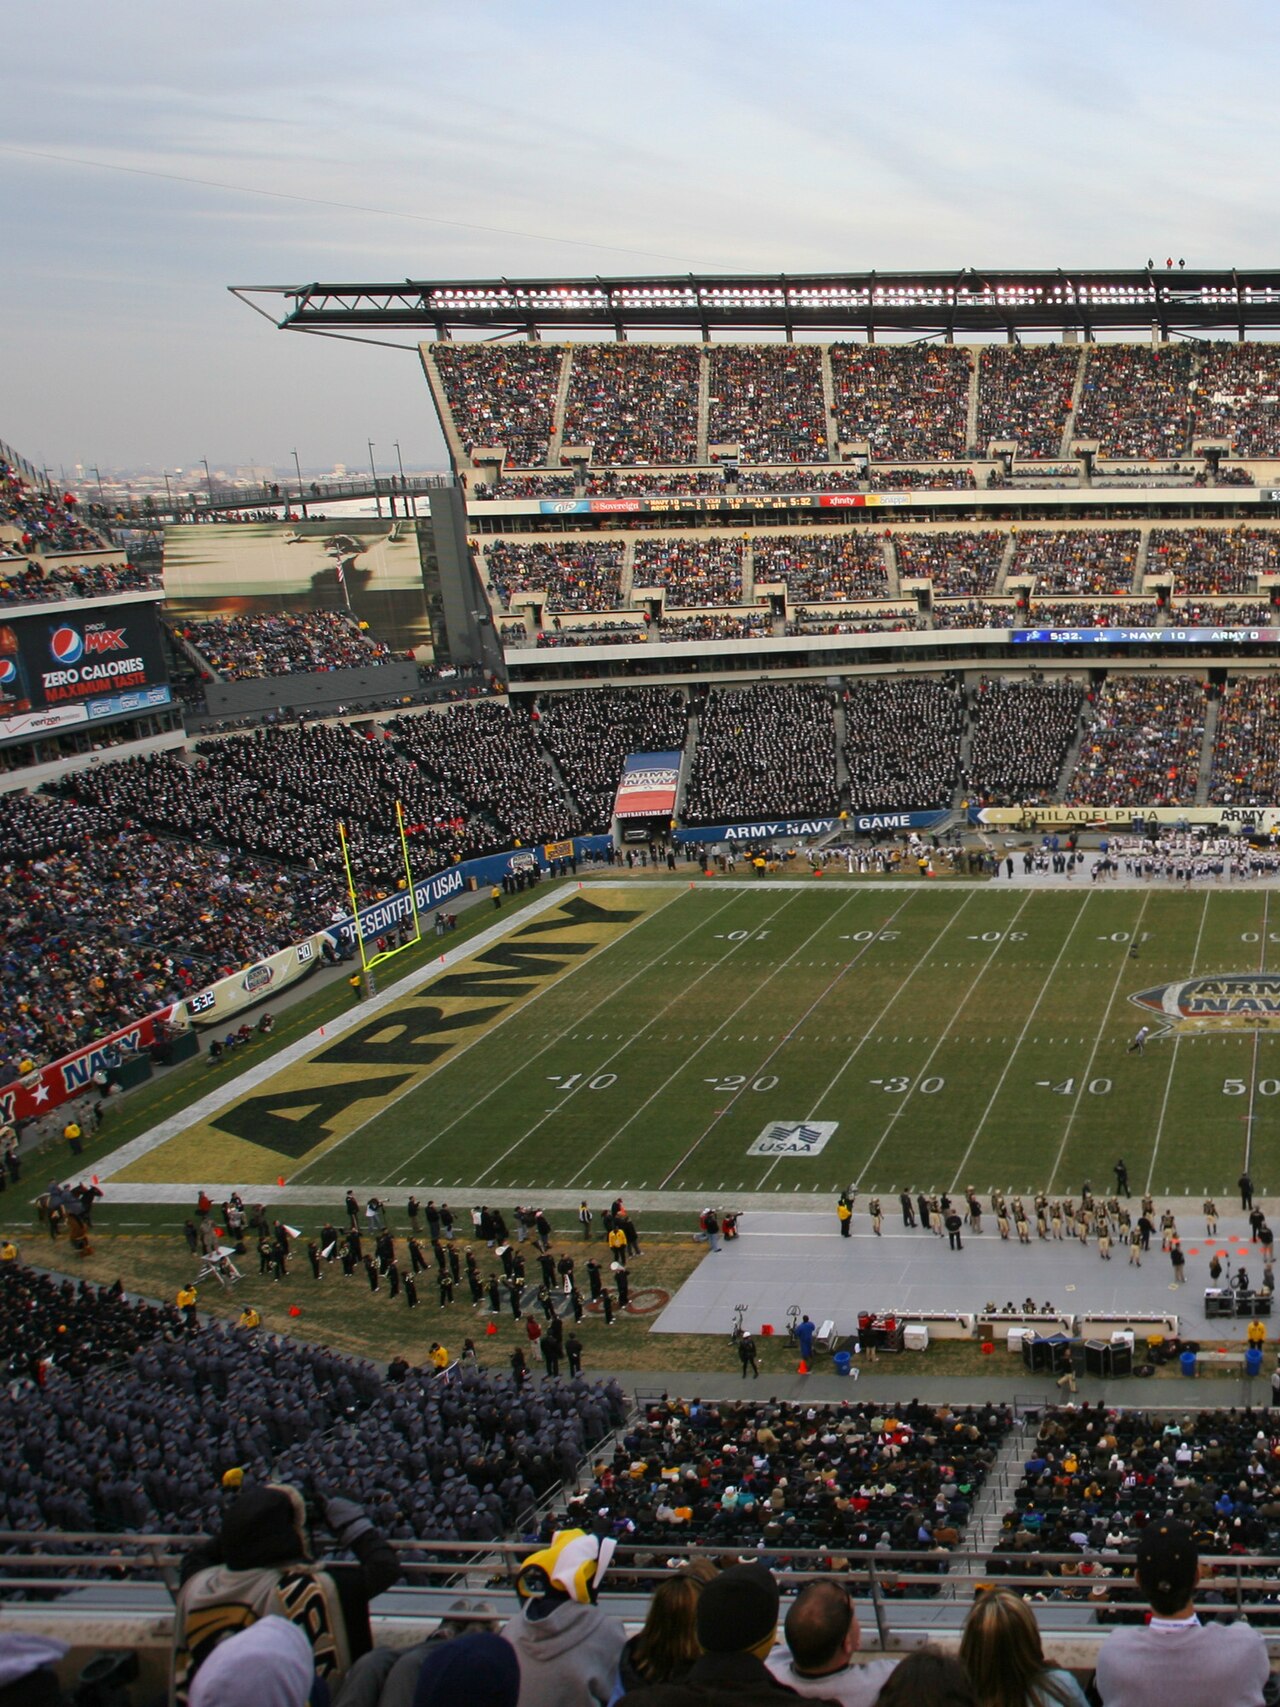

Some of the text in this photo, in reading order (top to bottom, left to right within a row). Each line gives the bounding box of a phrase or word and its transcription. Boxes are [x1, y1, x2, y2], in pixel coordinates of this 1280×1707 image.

[599, 501, 640, 511] Sovereign
[829, 495, 856, 506] xfinity
[84, 621, 107, 631] pepsi
[84, 627, 129, 655] MAX
[1129, 631, 1186, 640] NAVY 10
[1211, 631, 1259, 640] ARMY 0
[42, 657, 145, 688] ZERO CALORIES
[44, 671, 146, 702] MAXIMUM TASTE
[30, 715, 60, 726] verizon
[624, 777, 674, 786] NAVY
[627, 770, 674, 779] ARMY
[1023, 811, 1158, 821] PHILADELPHIA
[1221, 810, 1265, 821] ARMY
[725, 815, 911, 840] ARMY-NAVY GAME
[415, 885, 431, 909] BY
[432, 870, 463, 900] USAA
[297, 943, 311, 962] 40
[192, 991, 215, 1013] 5:32
[209, 896, 647, 1160] ARMY
[60, 1027, 141, 1095] NAY
[555, 1073, 618, 1090] 10
[713, 1075, 780, 1092] 20
[883, 1076, 945, 1094] 30
[1052, 1077, 1113, 1096] 40
[758, 1143, 812, 1152] USAA
